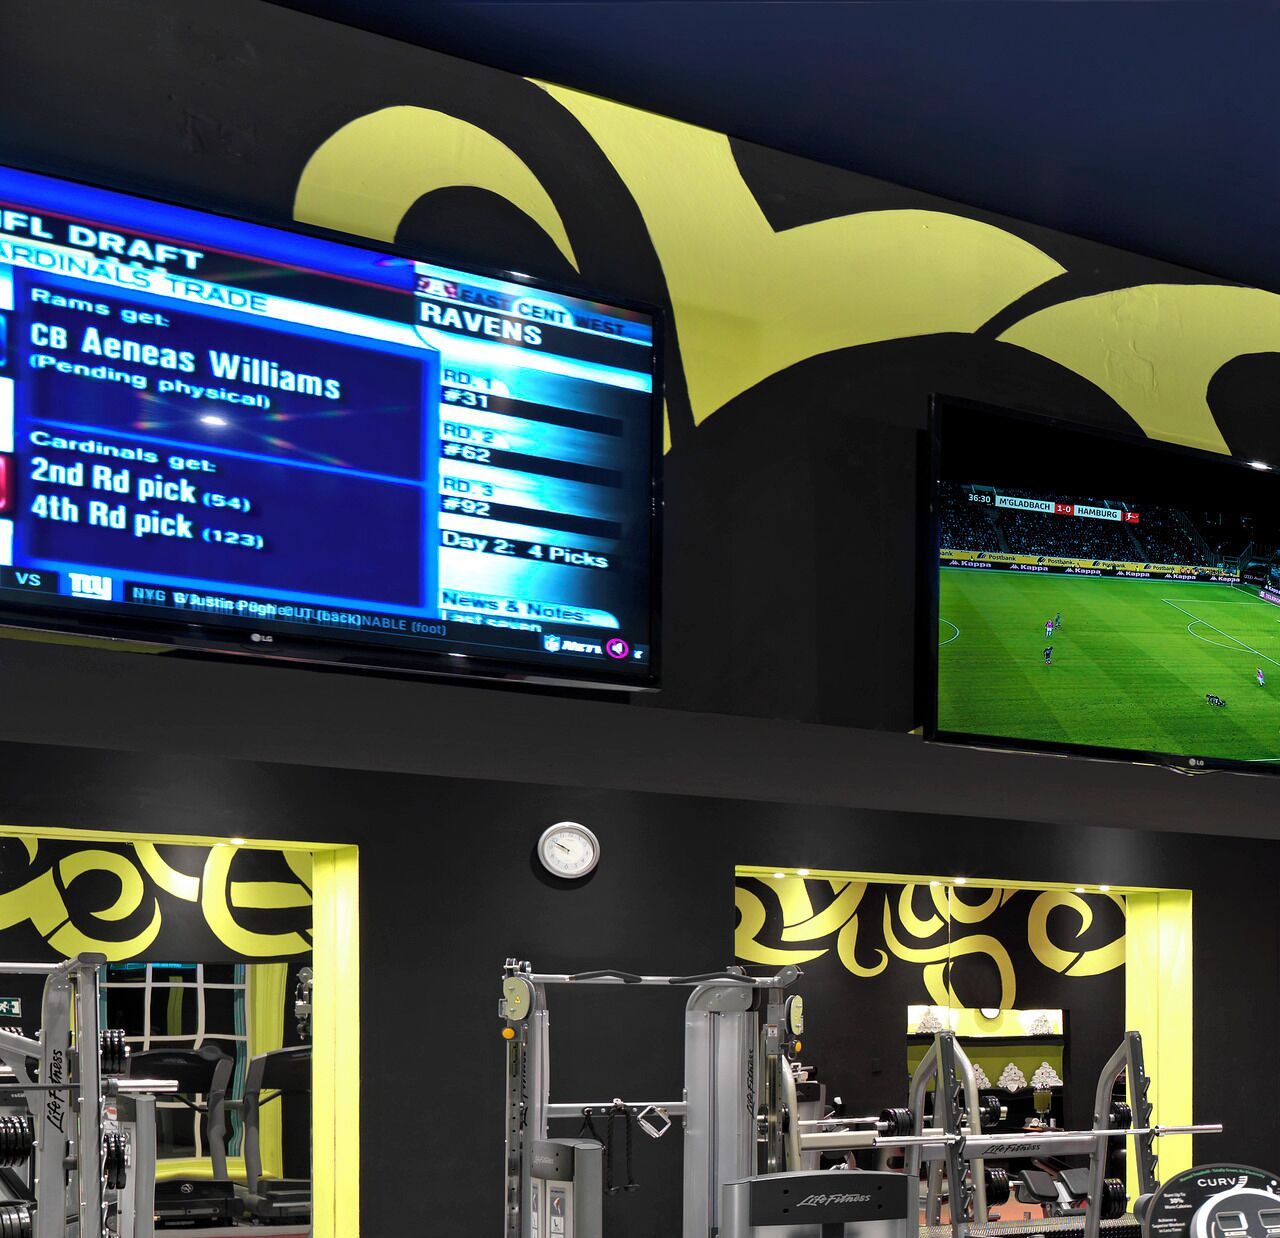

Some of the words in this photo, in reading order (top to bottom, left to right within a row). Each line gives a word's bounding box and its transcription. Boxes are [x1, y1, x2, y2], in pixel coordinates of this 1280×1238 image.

[0, 208, 53, 239] FL
[68, 224, 204, 270] DRAFT
[31, 287, 110, 316] Rams
[165, 276, 270, 313] TRADE
[420, 301, 543, 345] RAVENS
[517, 302, 566, 324] CENT
[575, 315, 624, 336] WEST
[30, 322, 67, 349] CB
[81, 326, 196, 373] Aeneas
[209, 349, 341, 400] Williams
[29, 354, 148, 389] (Pending
[158, 378, 271, 410] physical)
[444, 369, 477, 385] RD.
[444, 389, 489, 408] #31
[444, 423, 477, 441] RD.
[484, 431, 495, 443] 2
[29, 431, 159, 463] Cardinals
[444, 443, 491, 463] #62
[31, 457, 84, 487] 2nd
[92, 464, 130, 493] Rd
[138, 474, 197, 504] pick
[203, 492, 250, 513] (54)
[443, 477, 477, 494] RD.
[484, 484, 494, 497] 3
[443, 497, 490, 516] #92
[968, 493, 991, 503] 36:30
[999, 498, 1051, 511] M'GLADBACH
[1057, 505, 1071, 513] 1-0
[1078, 507, 1117, 519] HAMBURG
[31, 494, 79, 522] 4th
[89, 501, 127, 529] Rd
[134, 510, 194, 538] pick
[202, 528, 264, 550] (123)
[442, 530, 487, 553] Day
[493, 539, 515, 555] 2:
[528, 544, 543, 559] 4
[550, 547, 609, 569] Picks
[989, 554, 1016, 562] Postbank
[961, 560, 992, 569] Kappa
[1020, 564, 1049, 573] Kappa
[1075, 568, 1101, 576] Kappa
[15, 572, 41, 586] VS
[443, 591, 498, 611] News
[505, 599, 519, 614] &
[528, 602, 591, 622] Notes:
